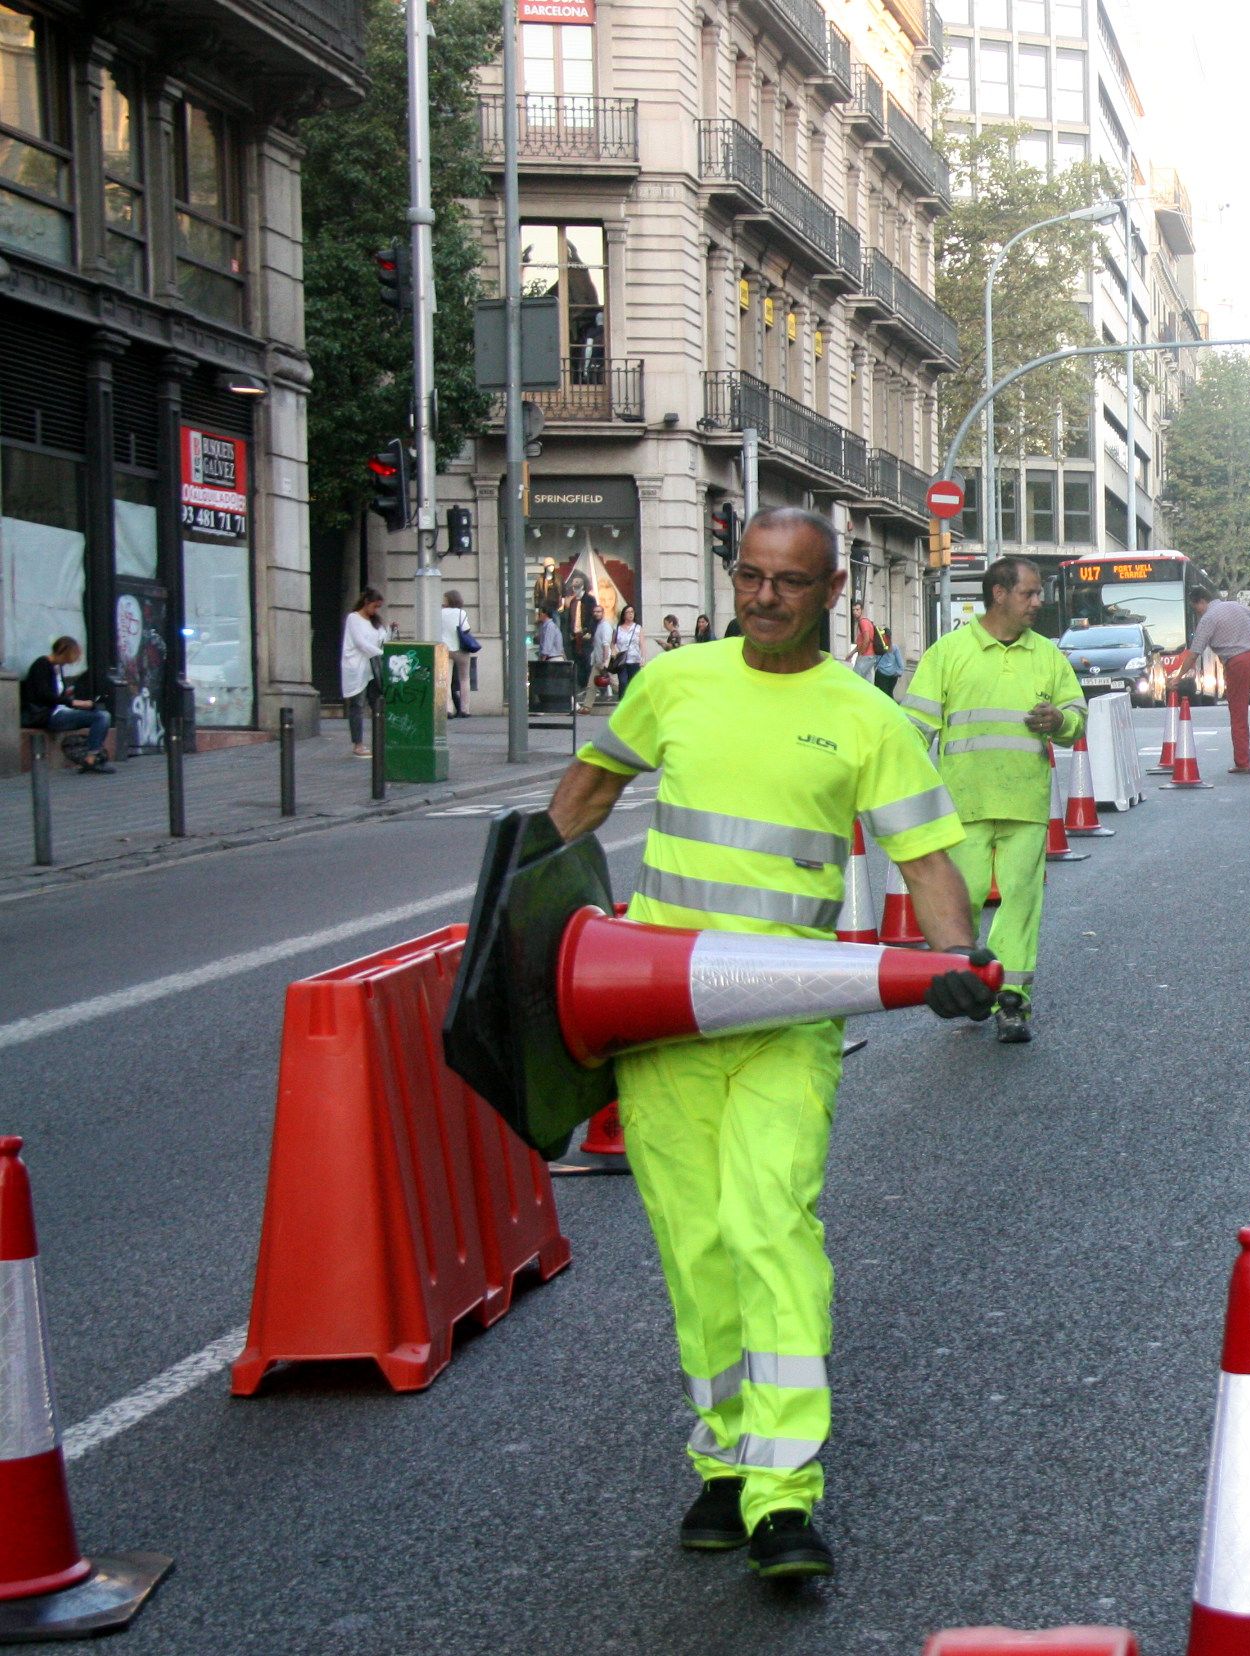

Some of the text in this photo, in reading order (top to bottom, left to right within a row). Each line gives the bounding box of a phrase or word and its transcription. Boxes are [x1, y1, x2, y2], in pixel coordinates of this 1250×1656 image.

[523, 4, 589, 17] BARCELONA
[534, 494, 603, 503] SPRINGFIELD
[196, 508, 215, 528] 481
[218, 511, 231, 531] 71
[234, 514, 246, 533] 71
[1080, 564, 1153, 581] V17 PORT VELL
